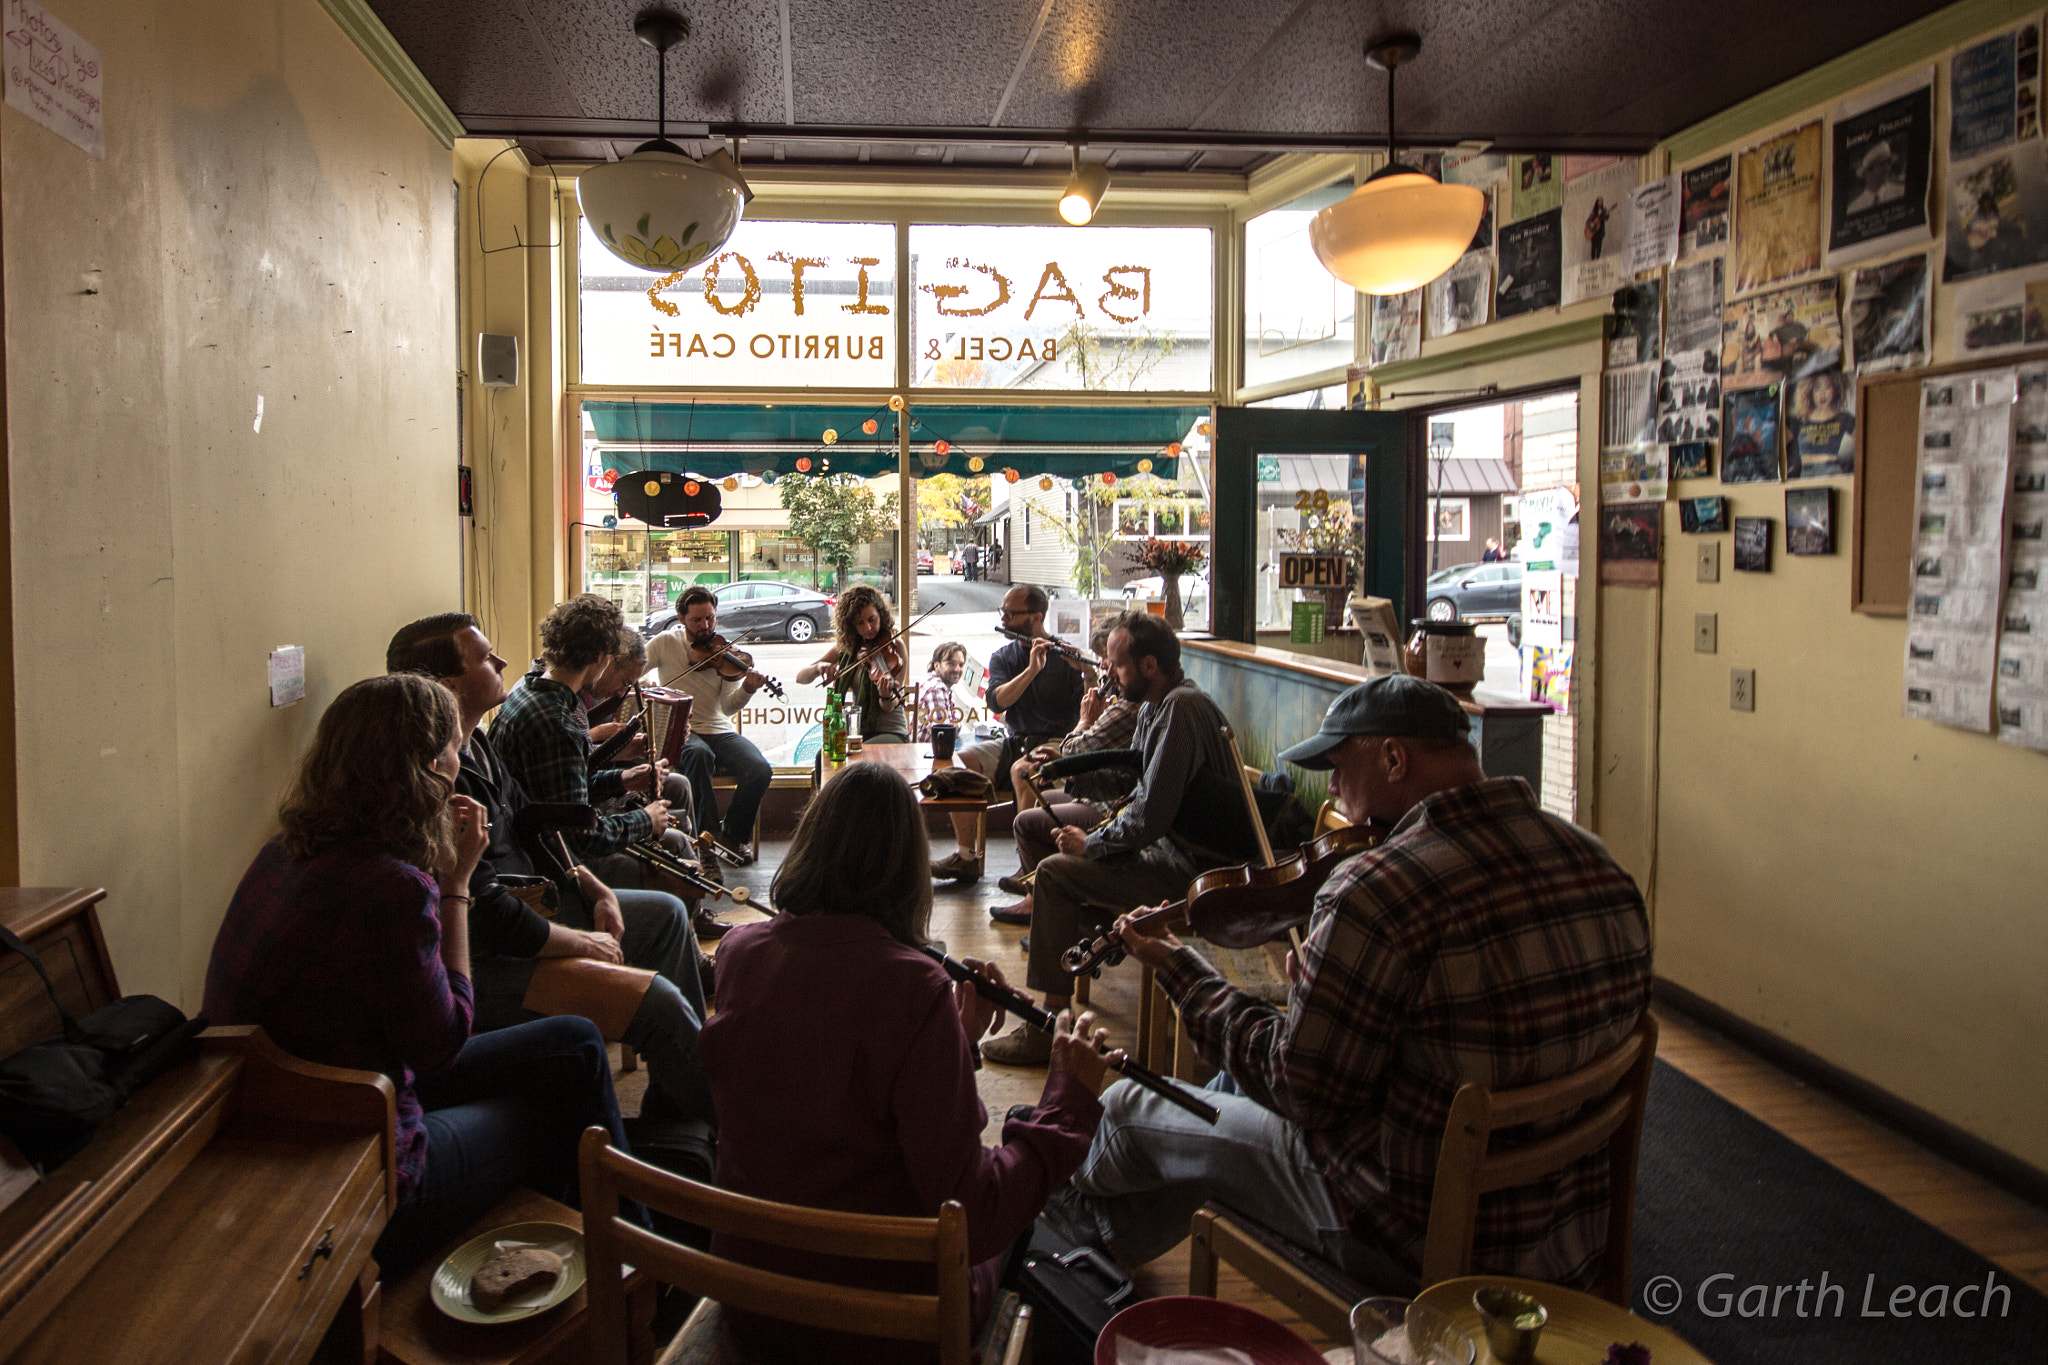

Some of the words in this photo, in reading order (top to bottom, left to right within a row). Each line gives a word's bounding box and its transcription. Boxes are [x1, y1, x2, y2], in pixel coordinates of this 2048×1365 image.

[1294, 488, 1330, 511] 28
[1284, 557, 1342, 585] OPEN
[670, 581, 724, 592] Weess
